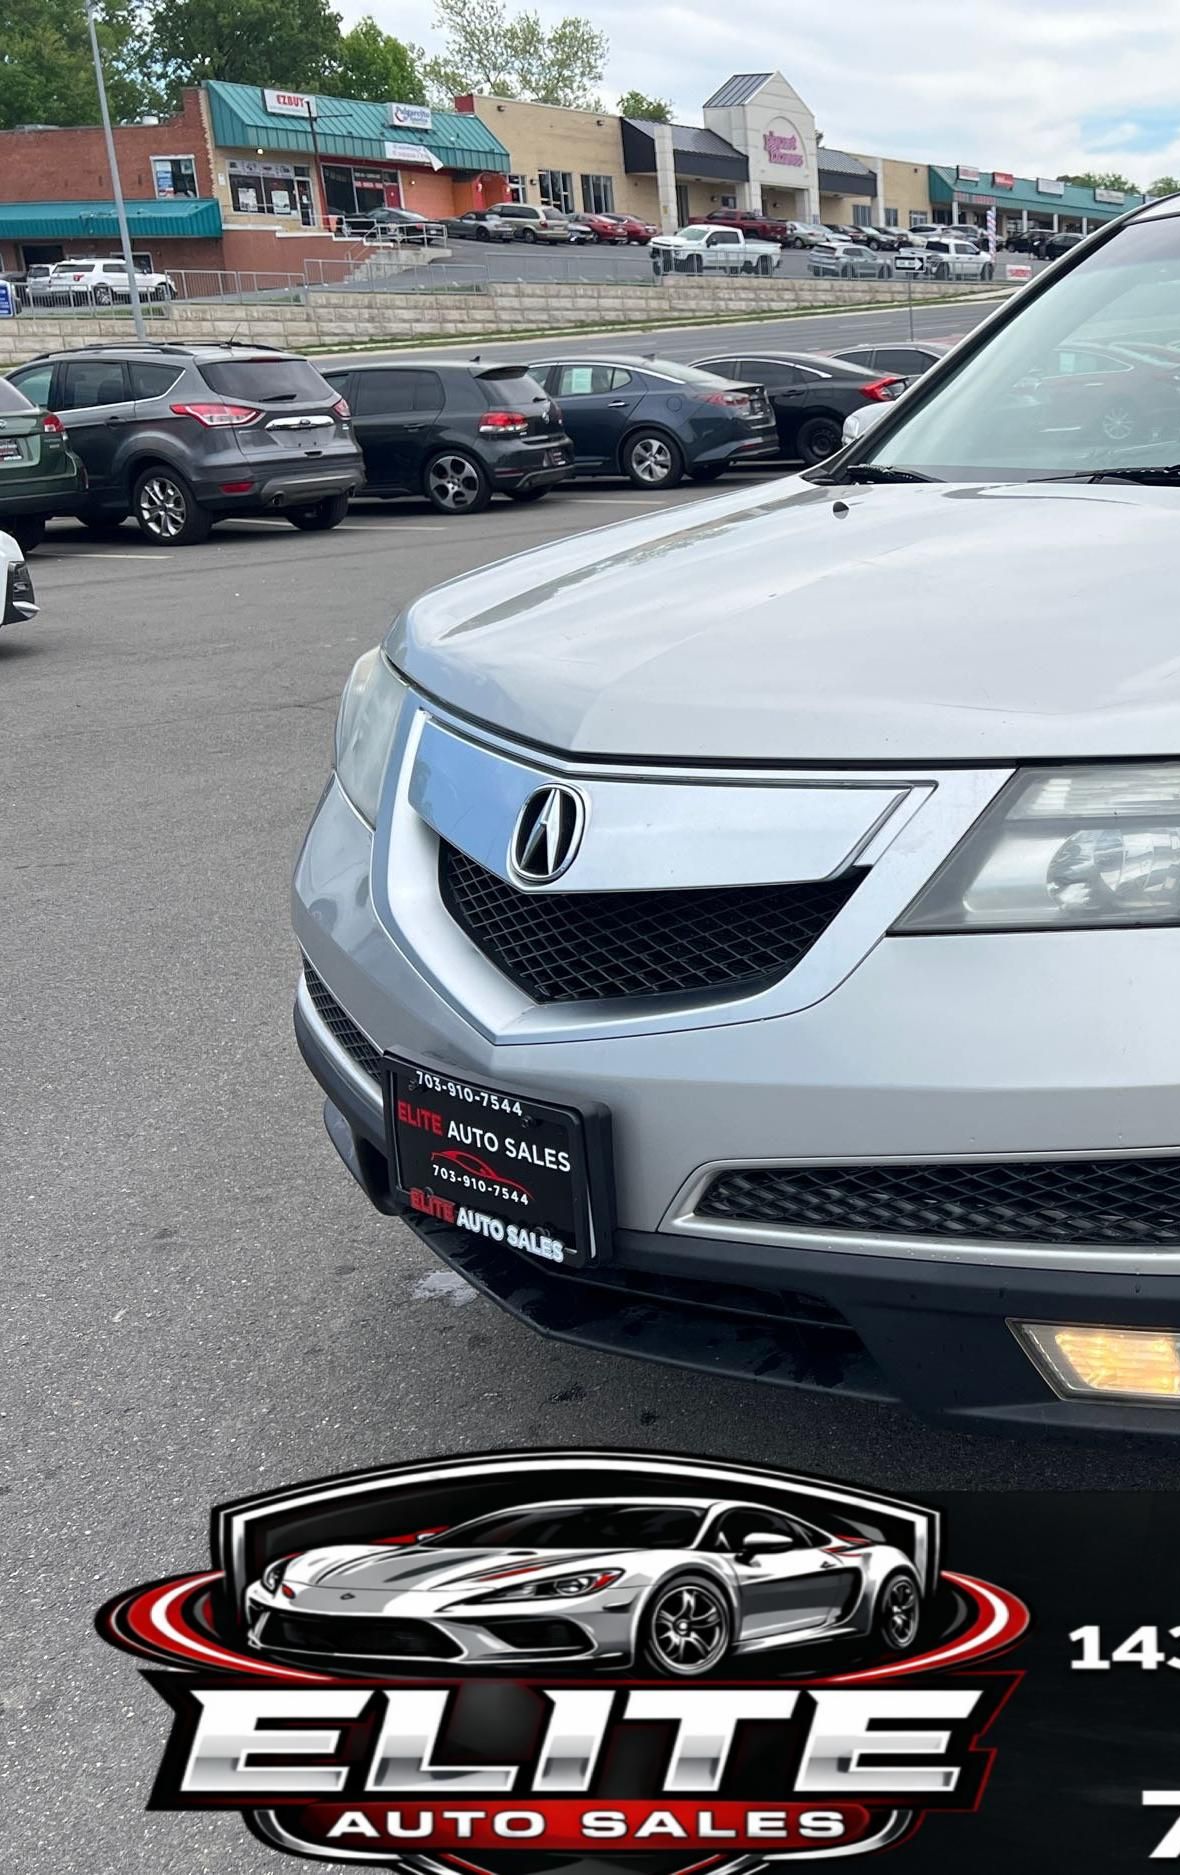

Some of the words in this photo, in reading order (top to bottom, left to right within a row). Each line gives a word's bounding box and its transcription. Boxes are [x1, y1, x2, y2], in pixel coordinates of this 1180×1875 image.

[416, 1071, 522, 1116] 703-910-7544
[398, 1101, 442, 1135] ELITE
[447, 1121, 499, 1153] AUTO
[505, 1138, 571, 1172] SALES
[432, 1164, 529, 1206] 703-910-7544
[410, 1189, 455, 1223] ELITE
[457, 1208, 504, 1241] AUTO
[507, 1225, 563, 1262] SALES
